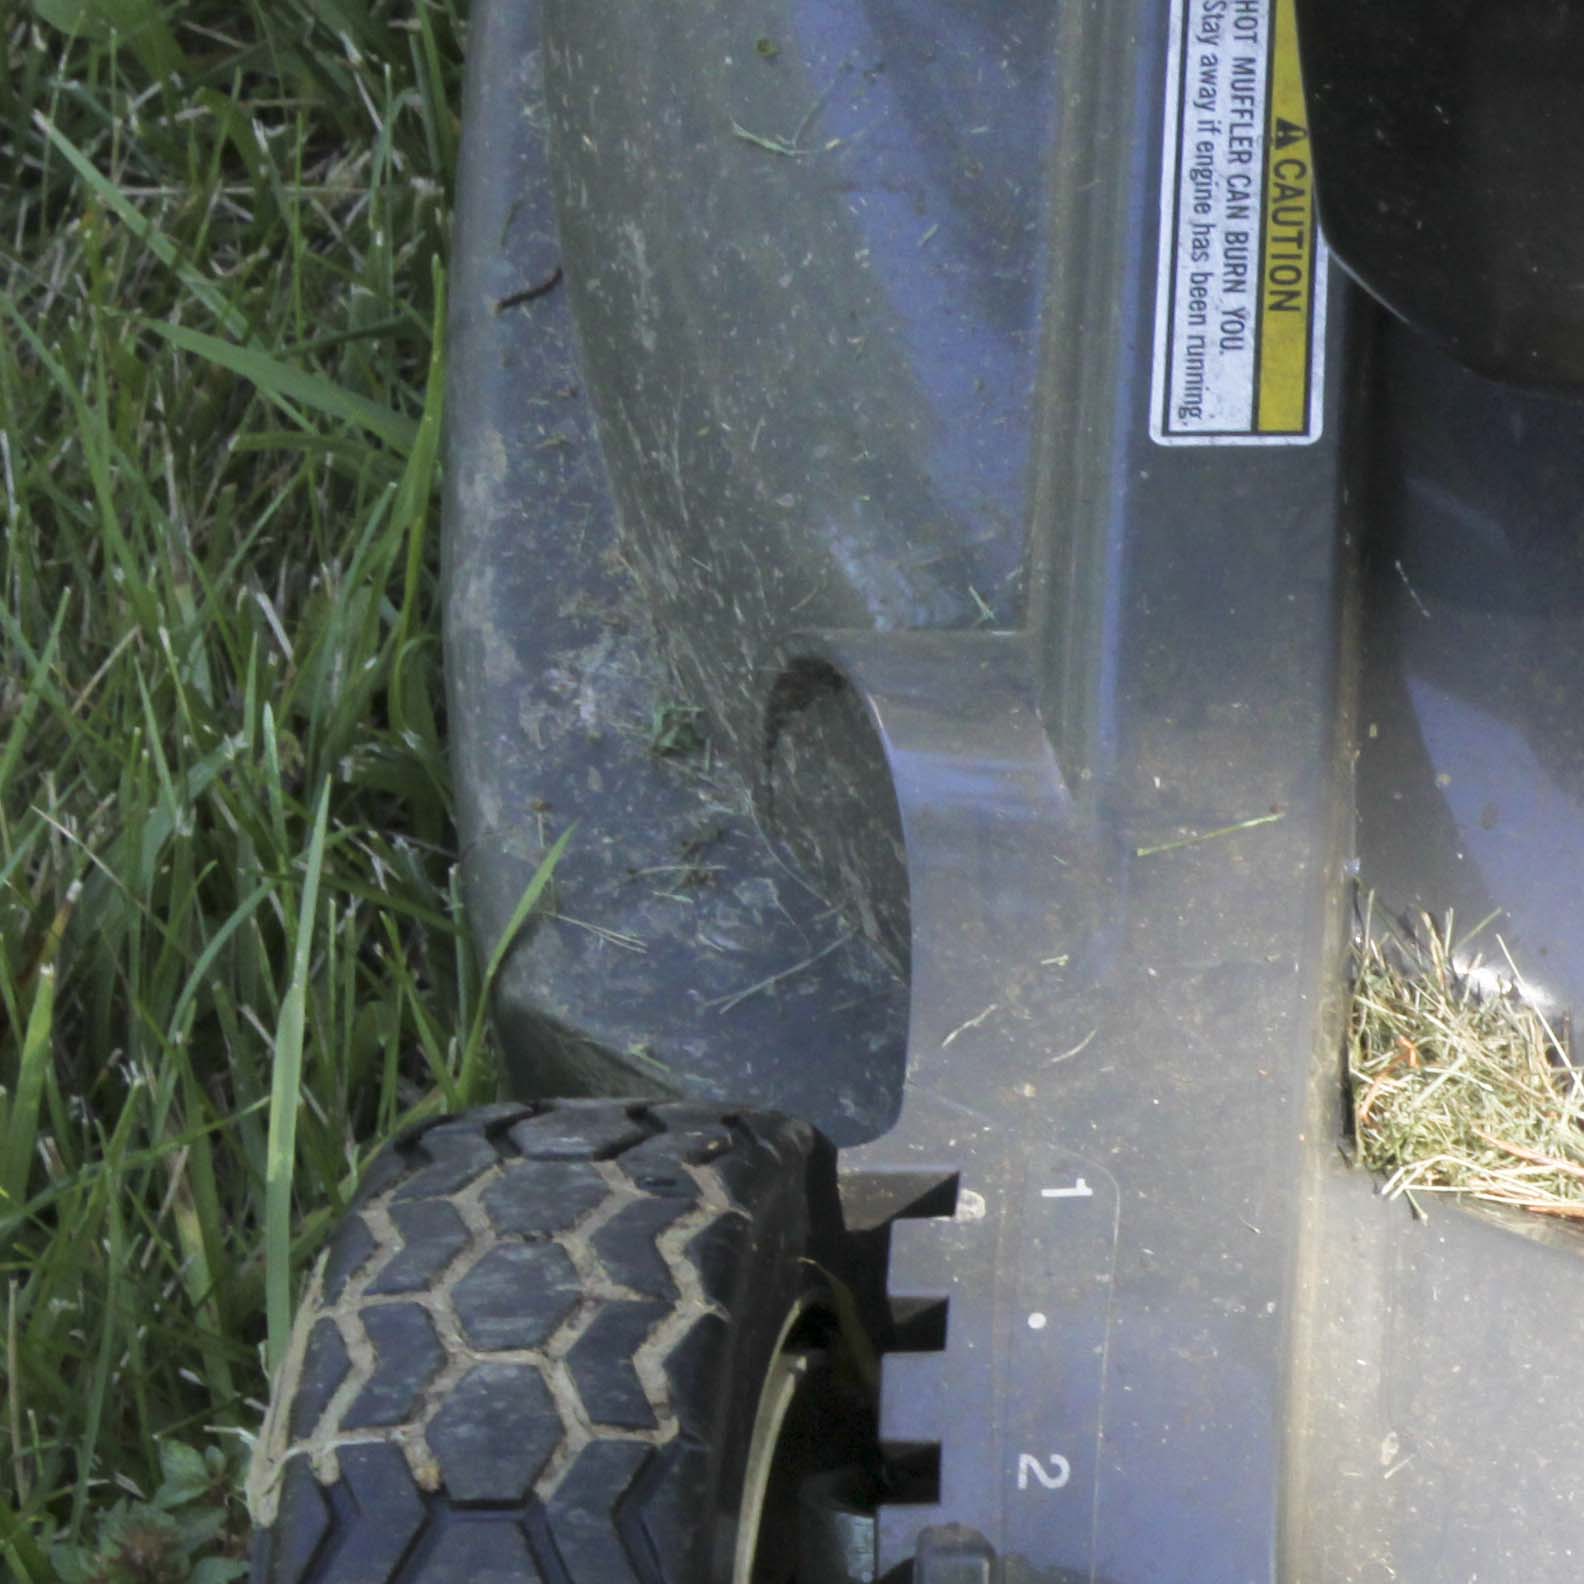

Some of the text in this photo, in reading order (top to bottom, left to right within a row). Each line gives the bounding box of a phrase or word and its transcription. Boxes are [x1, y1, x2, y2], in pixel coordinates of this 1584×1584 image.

[1178, 0, 1227, 426] Stay away if engine has been running.
[1219, 0, 1259, 356] HOT MUFFLER CAN BURN YOU.
[1268, 158, 1307, 312] CAUTION
[1041, 1177, 1093, 1198] 1
[1018, 1452, 1070, 1490] 2
